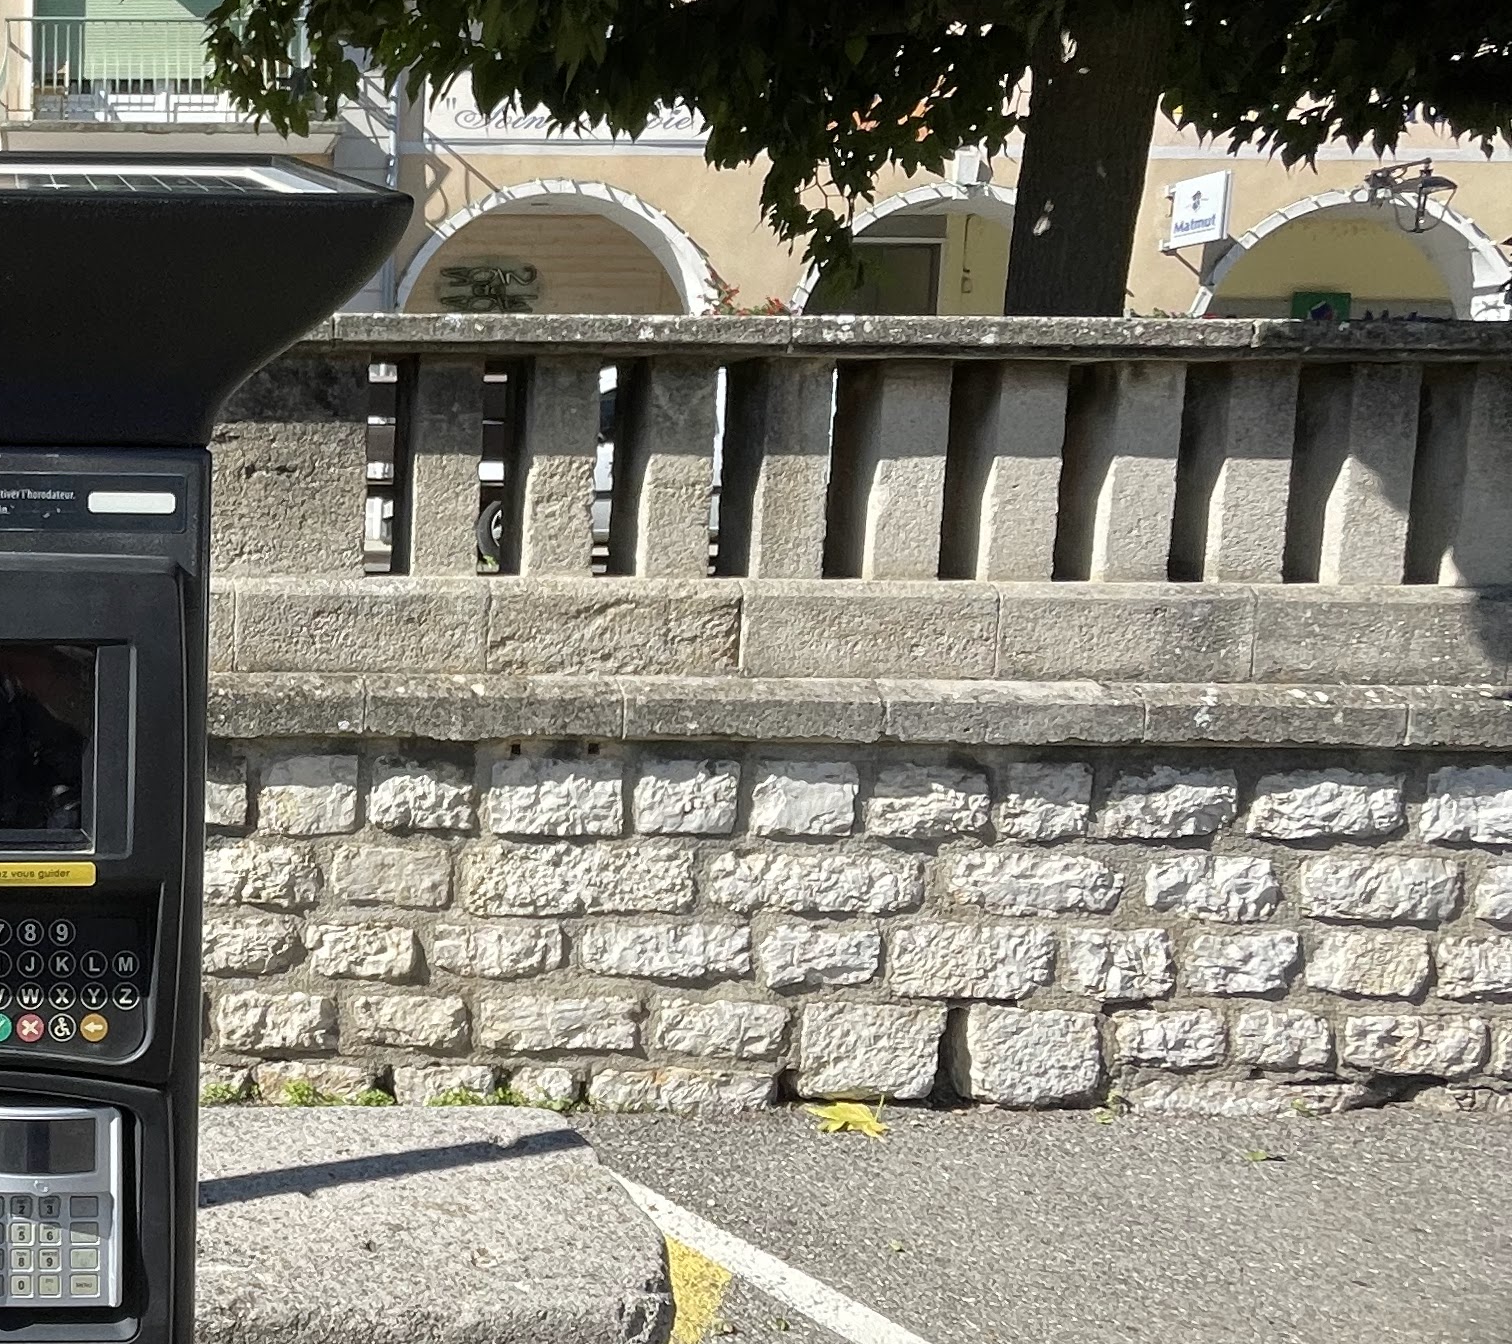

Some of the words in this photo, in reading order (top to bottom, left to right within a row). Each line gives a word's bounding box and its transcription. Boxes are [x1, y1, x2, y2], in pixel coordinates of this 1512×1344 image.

[1173, 213, 1216, 234] Matmut
[10, 870, 35, 878] vous
[38, 868, 70, 879] guider
[25, 924, 36, 942] 8
[57, 924, 68, 942] 9
[25, 957, 34, 972] J
[56, 957, 69, 972] K
[89, 957, 100, 972] L
[119, 957, 132, 972] M
[22, 989, 39, 1005] W
[56, 989, 69, 1005] X
[88, 989, 100, 1005] Y
[119, 989, 132, 1005] Z
